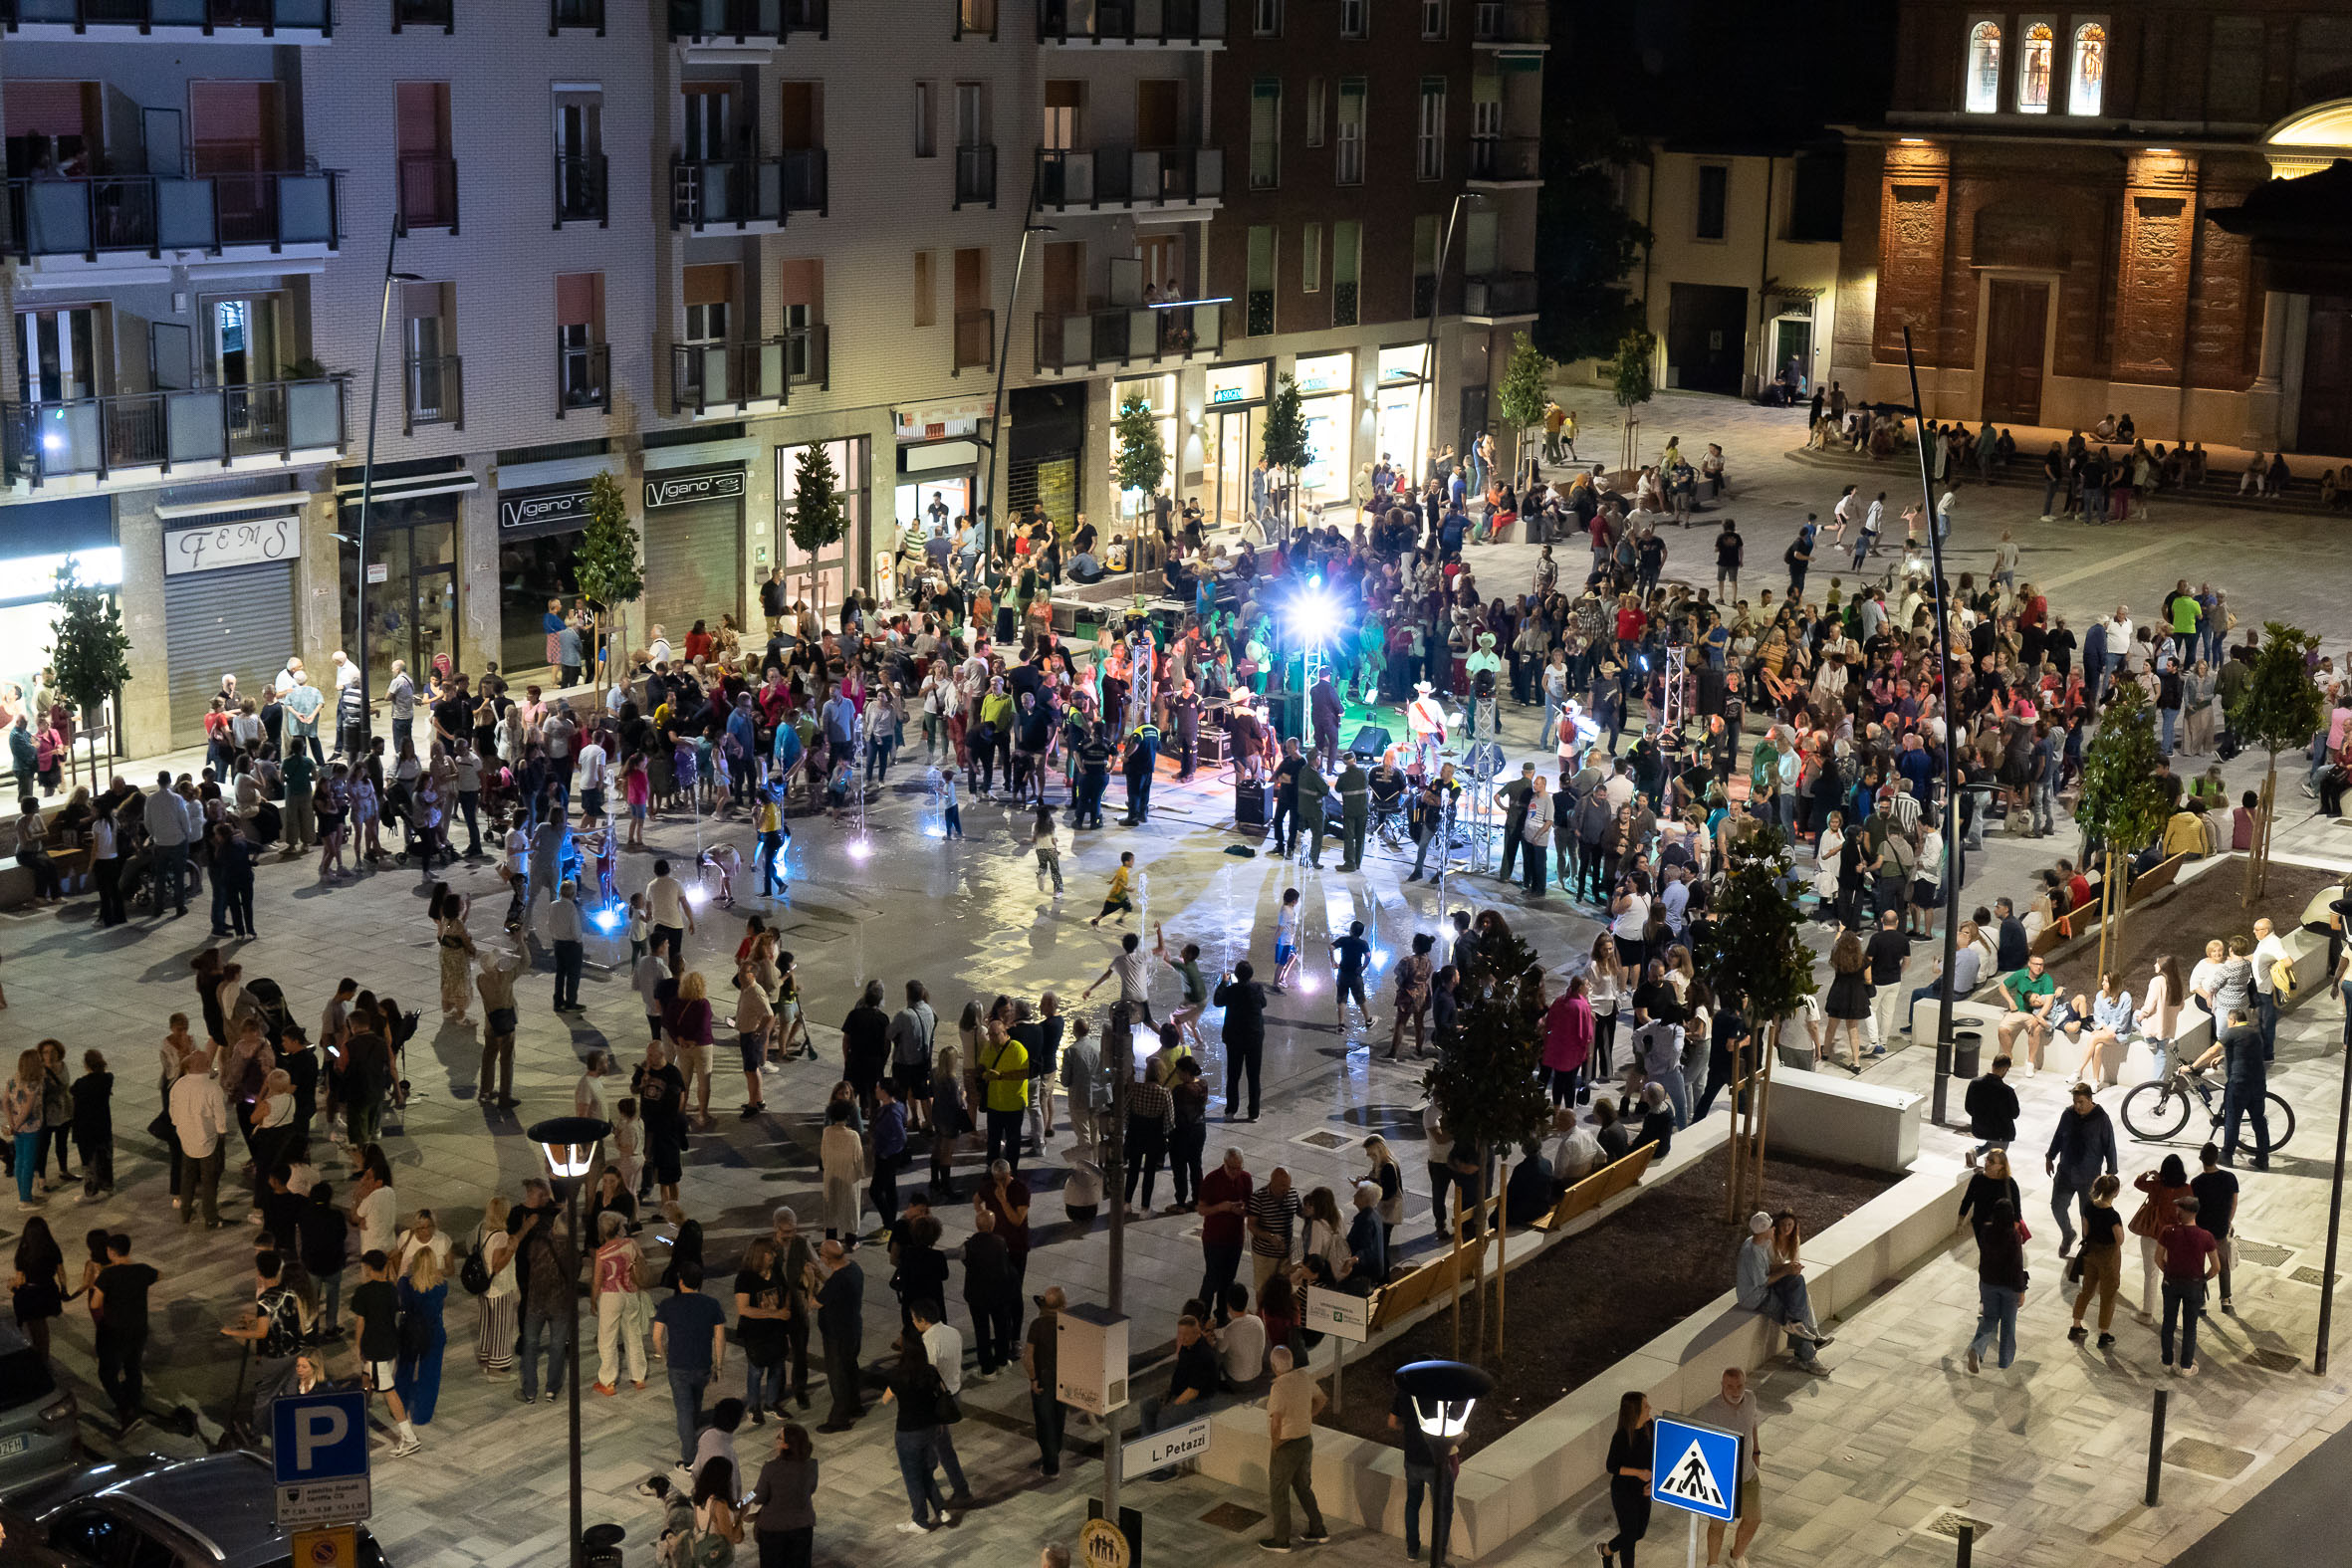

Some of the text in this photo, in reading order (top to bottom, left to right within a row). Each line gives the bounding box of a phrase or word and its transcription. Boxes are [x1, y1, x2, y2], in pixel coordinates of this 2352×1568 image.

[179, 521, 288, 568] FEMS
[295, 1405, 349, 1470] P
[1188, 1425, 1206, 1436] piazza
[0, 1438, 22, 1455] 2FH
[1152, 1434, 1206, 1462] L. Petazzi
